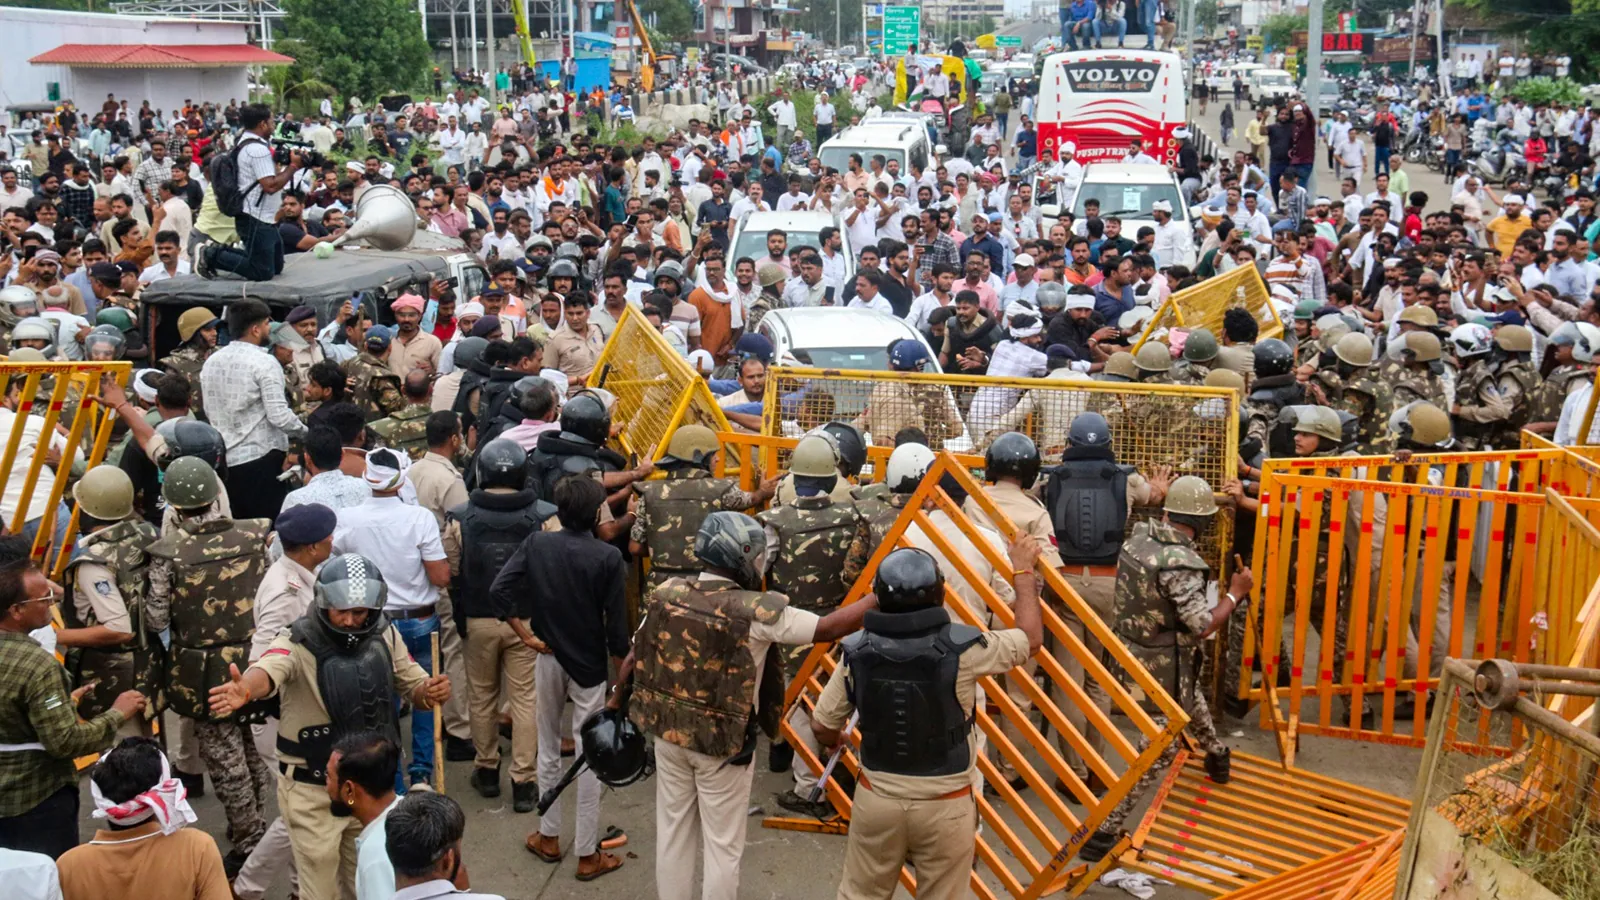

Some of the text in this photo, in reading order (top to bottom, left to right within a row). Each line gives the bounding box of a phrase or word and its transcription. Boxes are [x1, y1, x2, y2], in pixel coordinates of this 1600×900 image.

[1323, 33, 1363, 50] BAR
[1069, 68, 1154, 82] VOLVO
[1076, 147, 1130, 158] PUSHP TRAV
[1411, 456, 1430, 464] JAIL
[1420, 486, 1445, 496] PWD
[1448, 489, 1472, 498] JAIL
